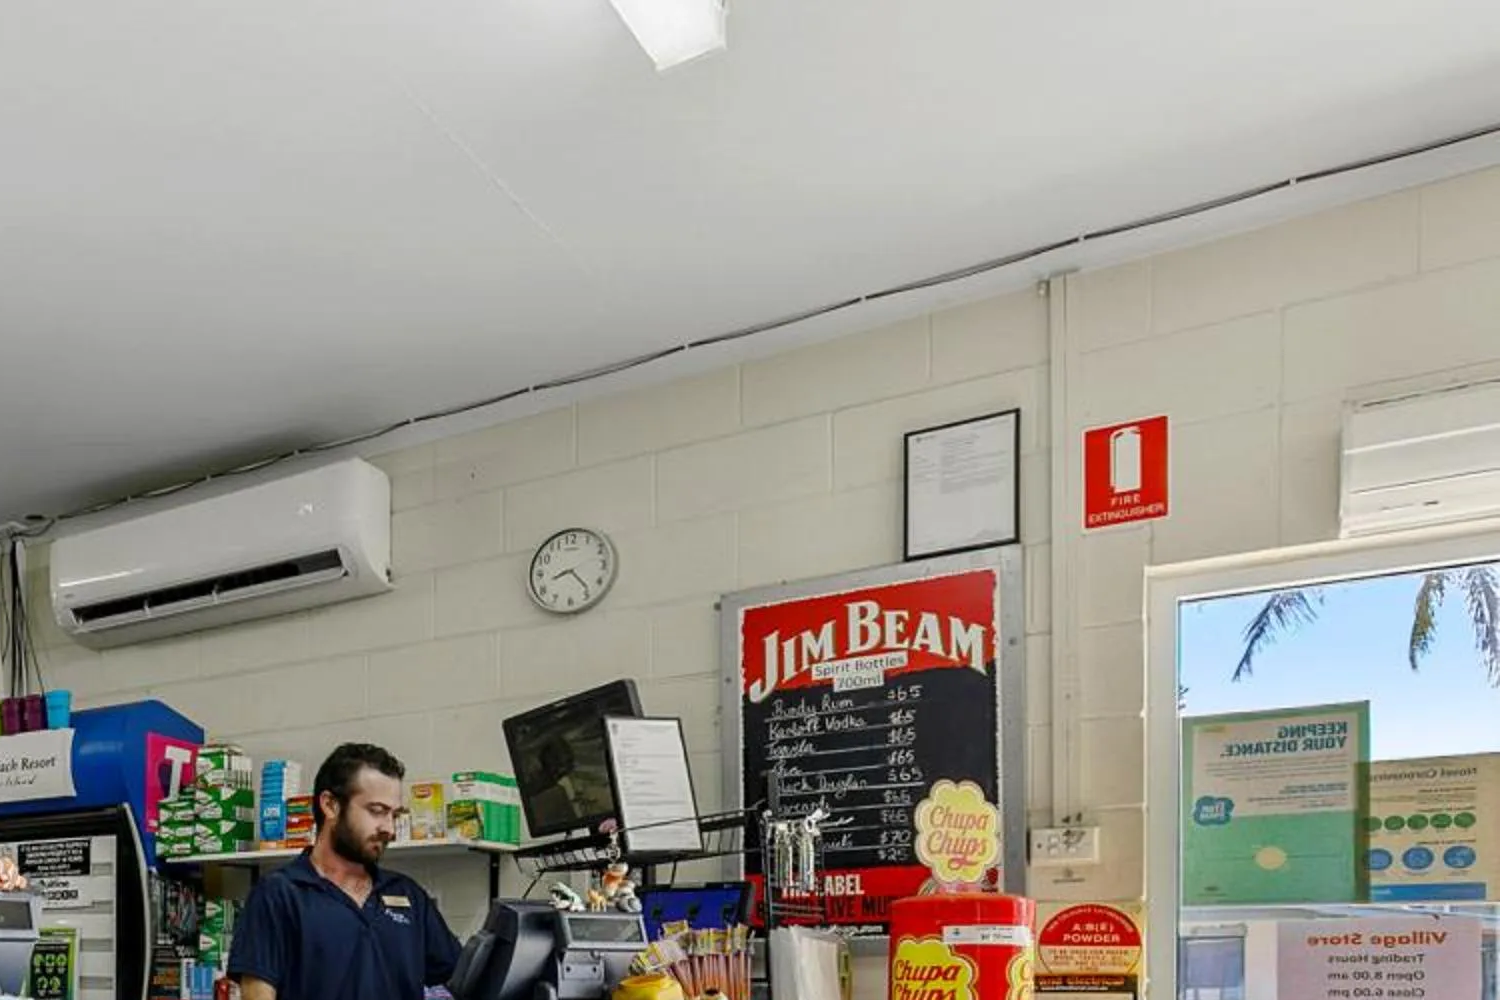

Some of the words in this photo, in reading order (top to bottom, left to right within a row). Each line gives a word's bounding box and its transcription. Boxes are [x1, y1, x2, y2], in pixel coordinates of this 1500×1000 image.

[1110, 494, 1141, 506] FIRE
[749, 619, 837, 703] JIM
[845, 600, 988, 677] BEAM
[814, 662, 850, 679] Spirit
[853, 655, 905, 673] Bottles
[837, 672, 882, 690] 700ml
[20, 757, 56, 771] Resort
[928, 806, 988, 839] Chupa
[926, 830, 987, 869] Chups
[814, 874, 865, 897] ABEL
[1063, 932, 1121, 944] POWDER
[891, 958, 962, 988] Chupa
